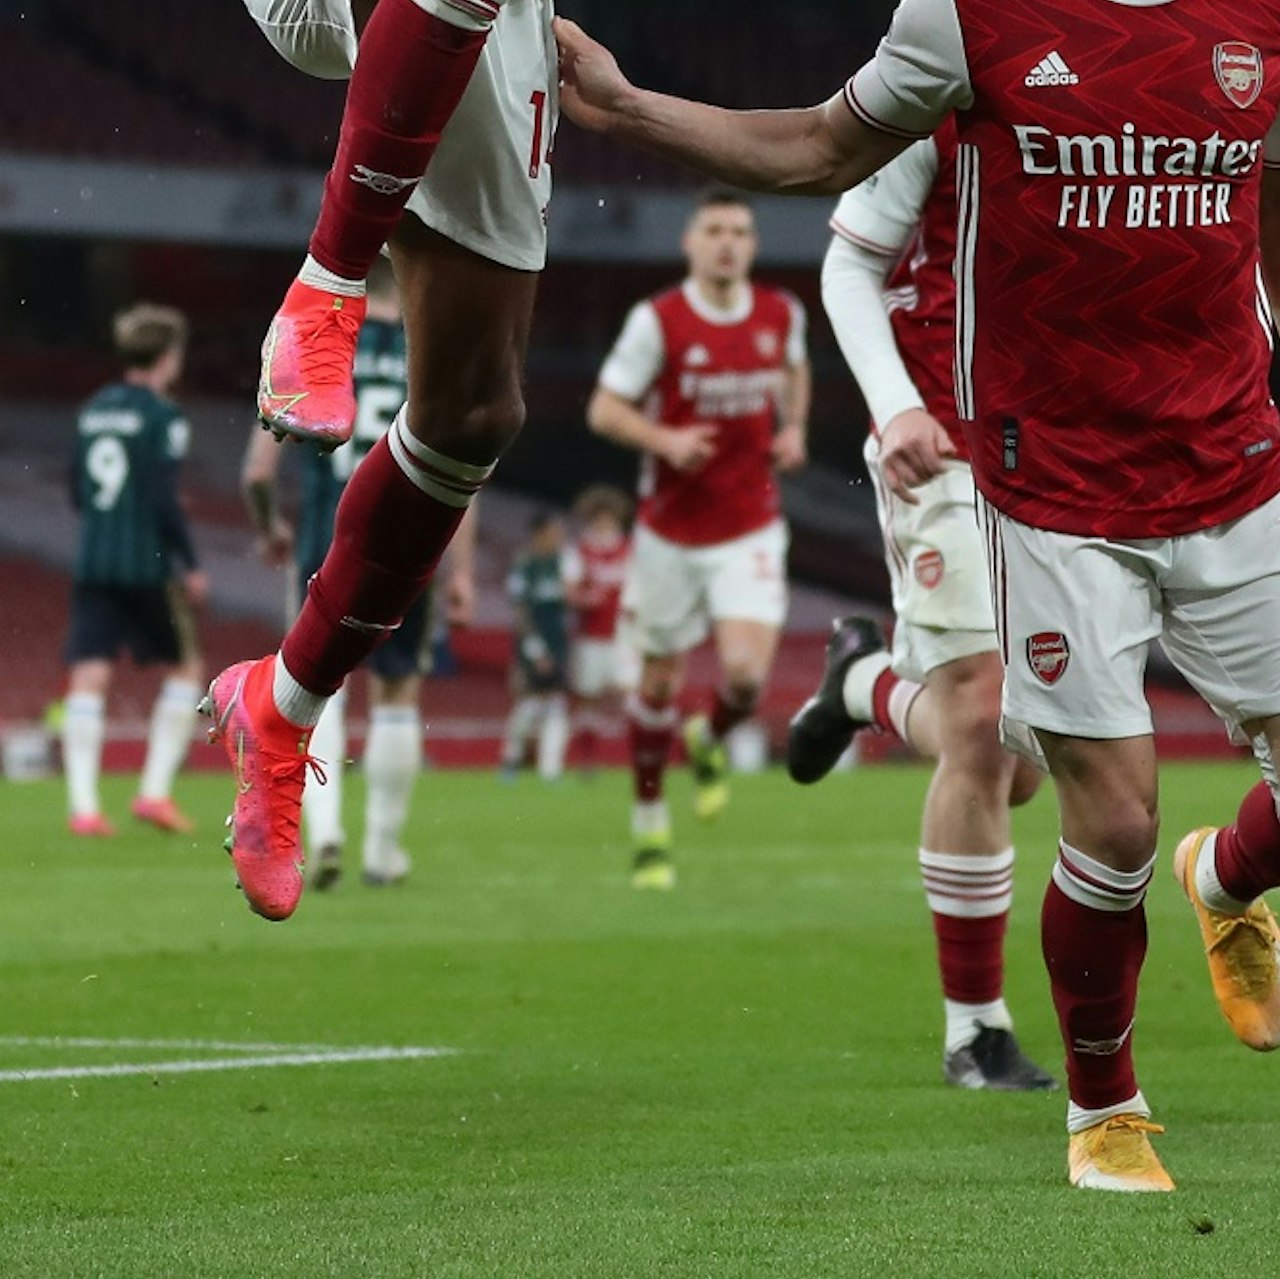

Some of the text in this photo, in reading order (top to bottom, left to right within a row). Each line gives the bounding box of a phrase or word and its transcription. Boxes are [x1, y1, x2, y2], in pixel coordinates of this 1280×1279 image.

[1024, 73, 1079, 88] adidas
[528, 90, 554, 179] 1
[1014, 122, 1263, 177] Emirates
[1057, 183, 1231, 229] FLY BETTER
[86, 436, 129, 511] 9
